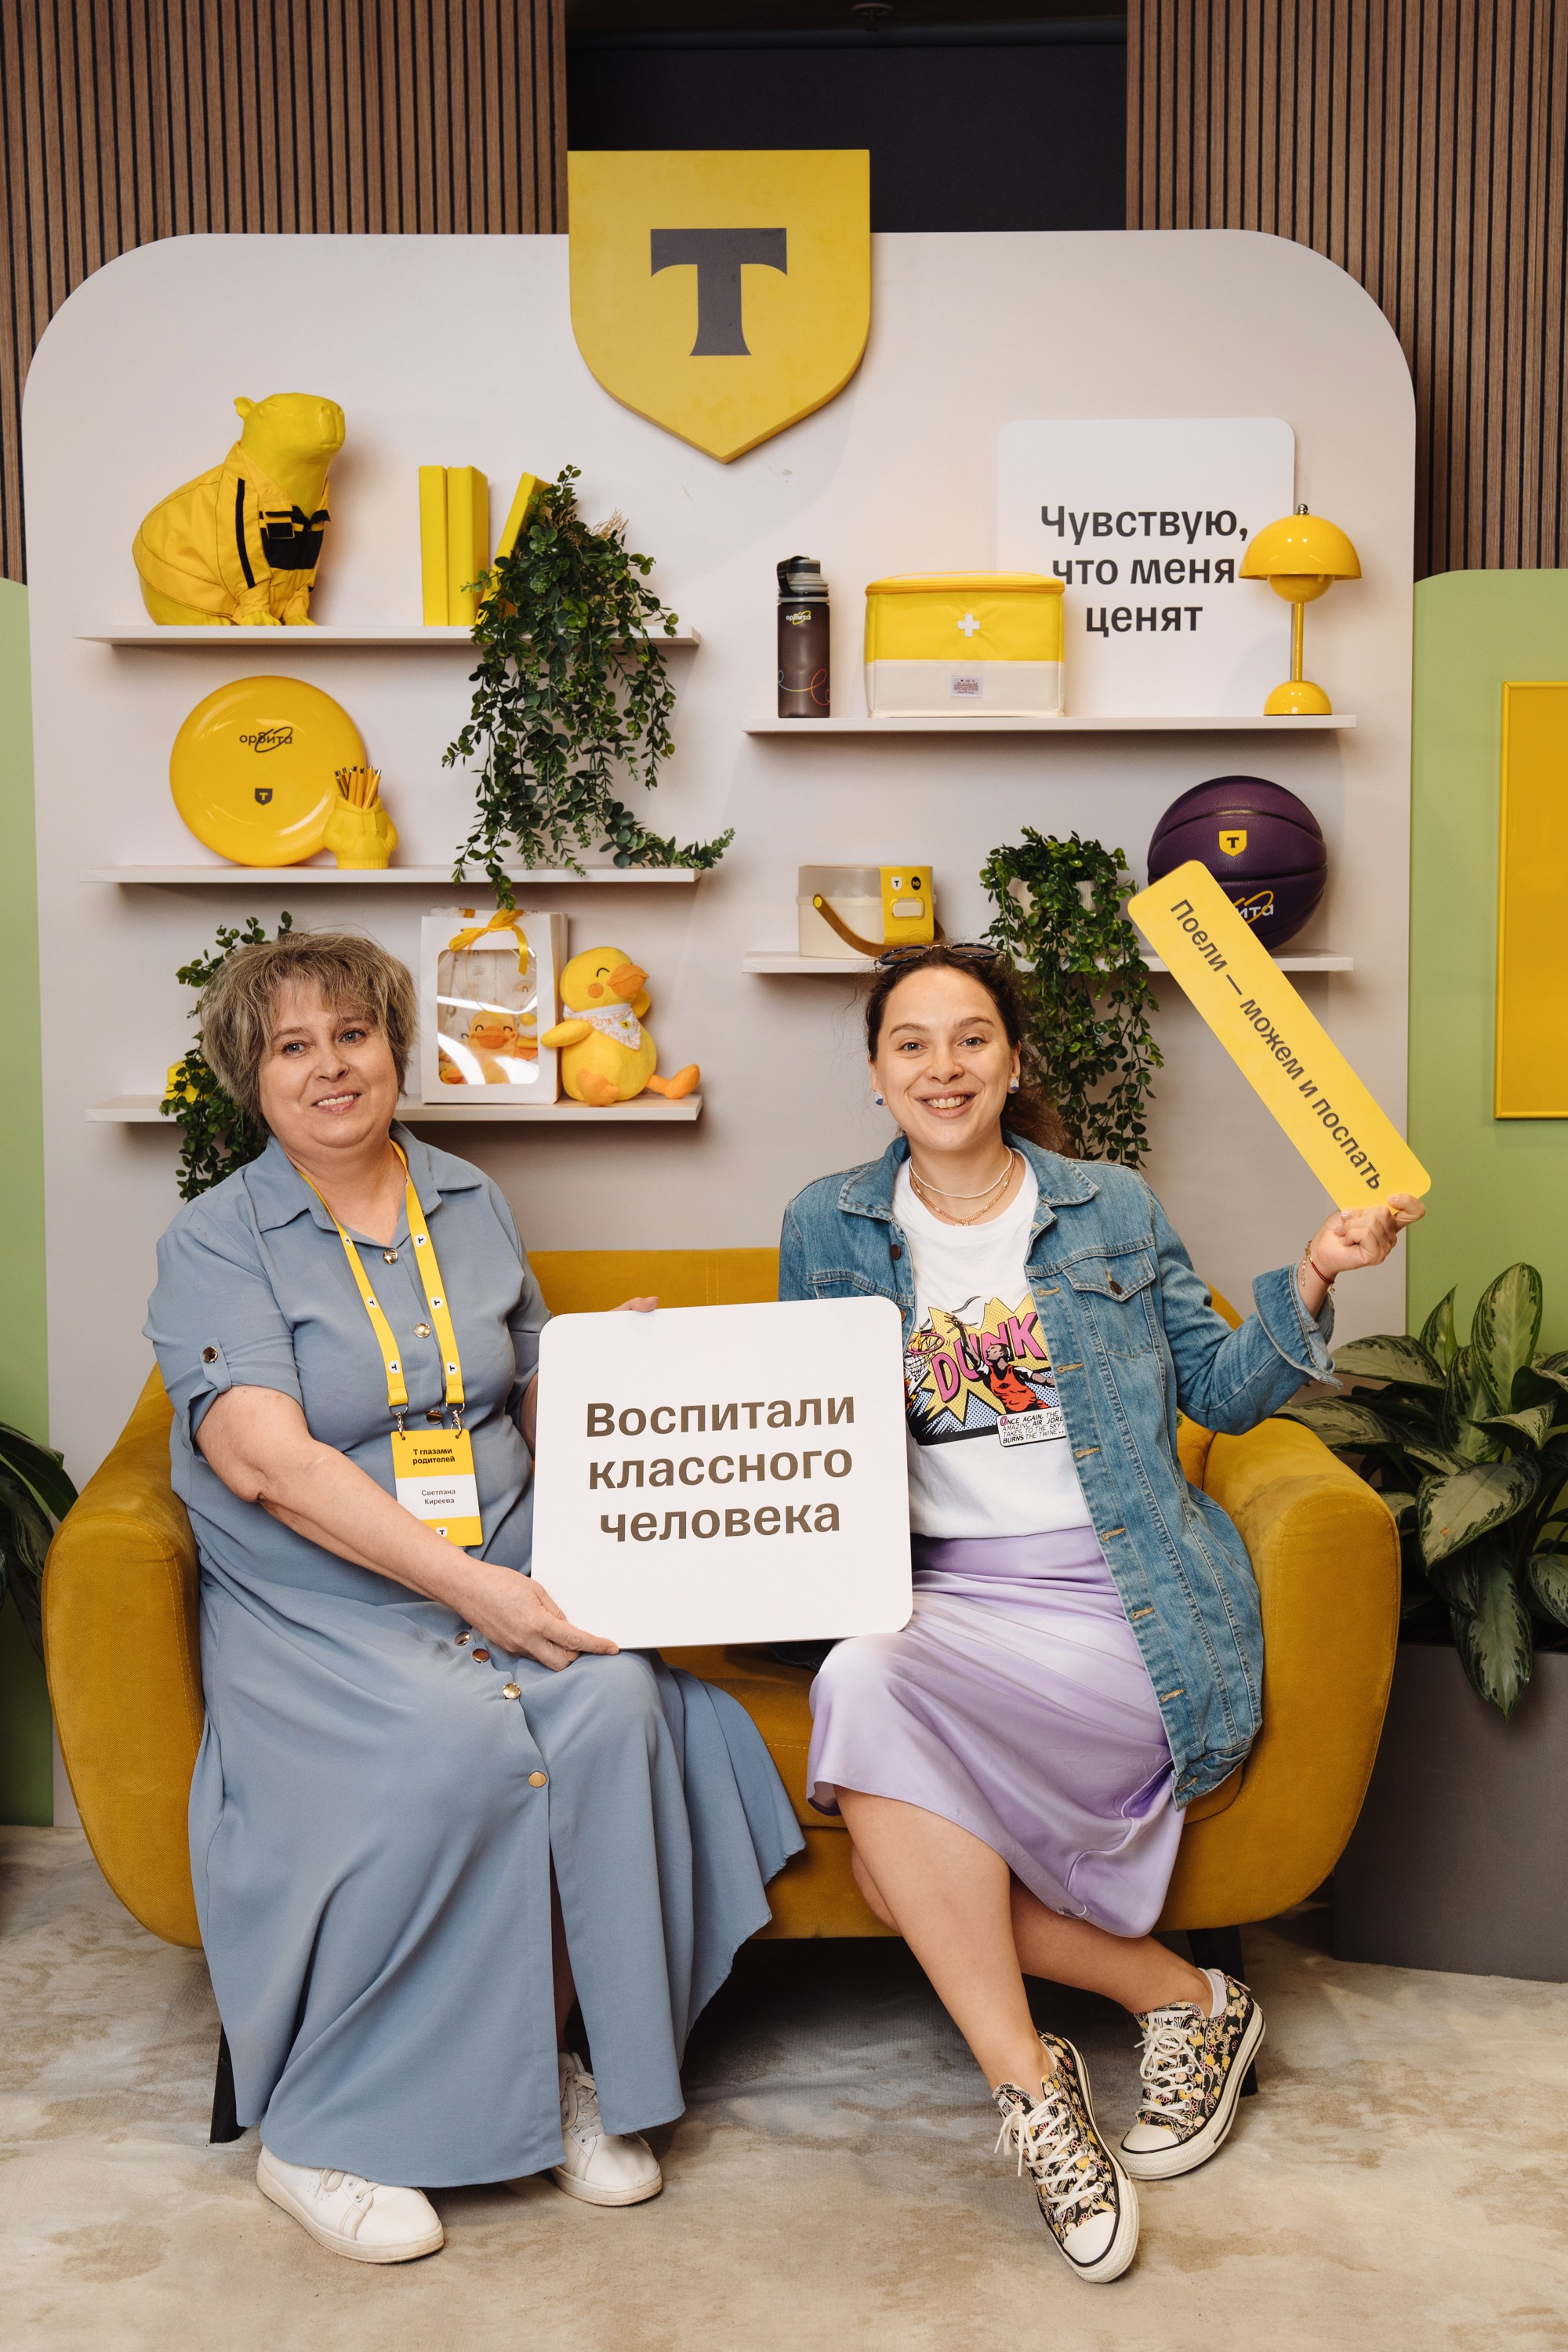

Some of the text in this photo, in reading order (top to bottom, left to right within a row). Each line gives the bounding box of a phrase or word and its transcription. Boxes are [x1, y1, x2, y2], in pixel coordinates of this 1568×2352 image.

[1041, 506, 1248, 546] Чувствую,
[1052, 558, 1235, 586] что меня
[786, 611, 811, 622] орбита
[1086, 606, 1203, 638] ценят
[239, 731, 293, 747] орбита
[1236, 903, 1274, 920] ита
[1170, 898, 1229, 973] Поели
[1239, 998, 1305, 1081] можем
[1298, 1079, 1319, 1099] и
[1312, 1098, 1381, 1191] поспать
[931, 1312, 1047, 1403] DUNK
[586, 1396, 855, 1438] Воспитали
[1000, 1415, 1020, 1427] ONCE
[1002, 1421, 1031, 1432] AMAZING
[1003, 1429, 1022, 1438] TAKES
[1003, 1435, 1024, 1444] BURNS
[412, 1456, 456, 1465] родителей
[589, 1449, 852, 1490] классного
[601, 1503, 840, 1542] человека
